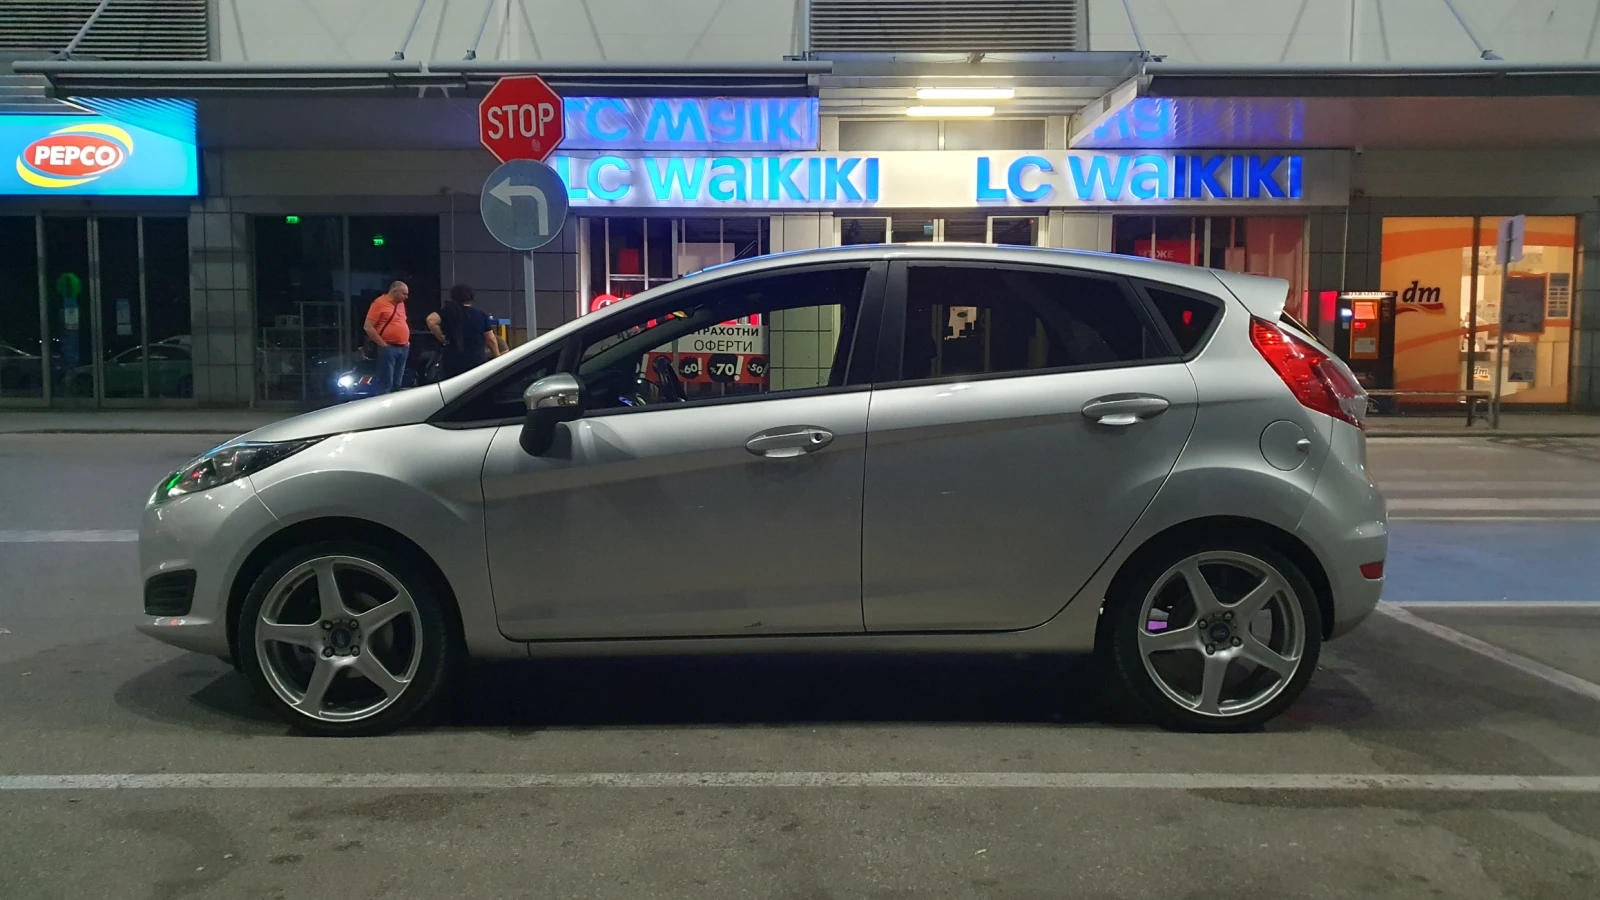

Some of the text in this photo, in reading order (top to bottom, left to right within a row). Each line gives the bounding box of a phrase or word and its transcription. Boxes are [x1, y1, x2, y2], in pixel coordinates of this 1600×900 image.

[487, 102, 555, 140] STOP
[34, 145, 117, 167] PEPCO
[557, 155, 632, 201] LC
[976, 155, 1054, 201] LC
[1402, 280, 1441, 303] dm
[690, 326, 759, 337] ТРАХОТНИ
[694, 339, 753, 353] ОФЕРТИ
